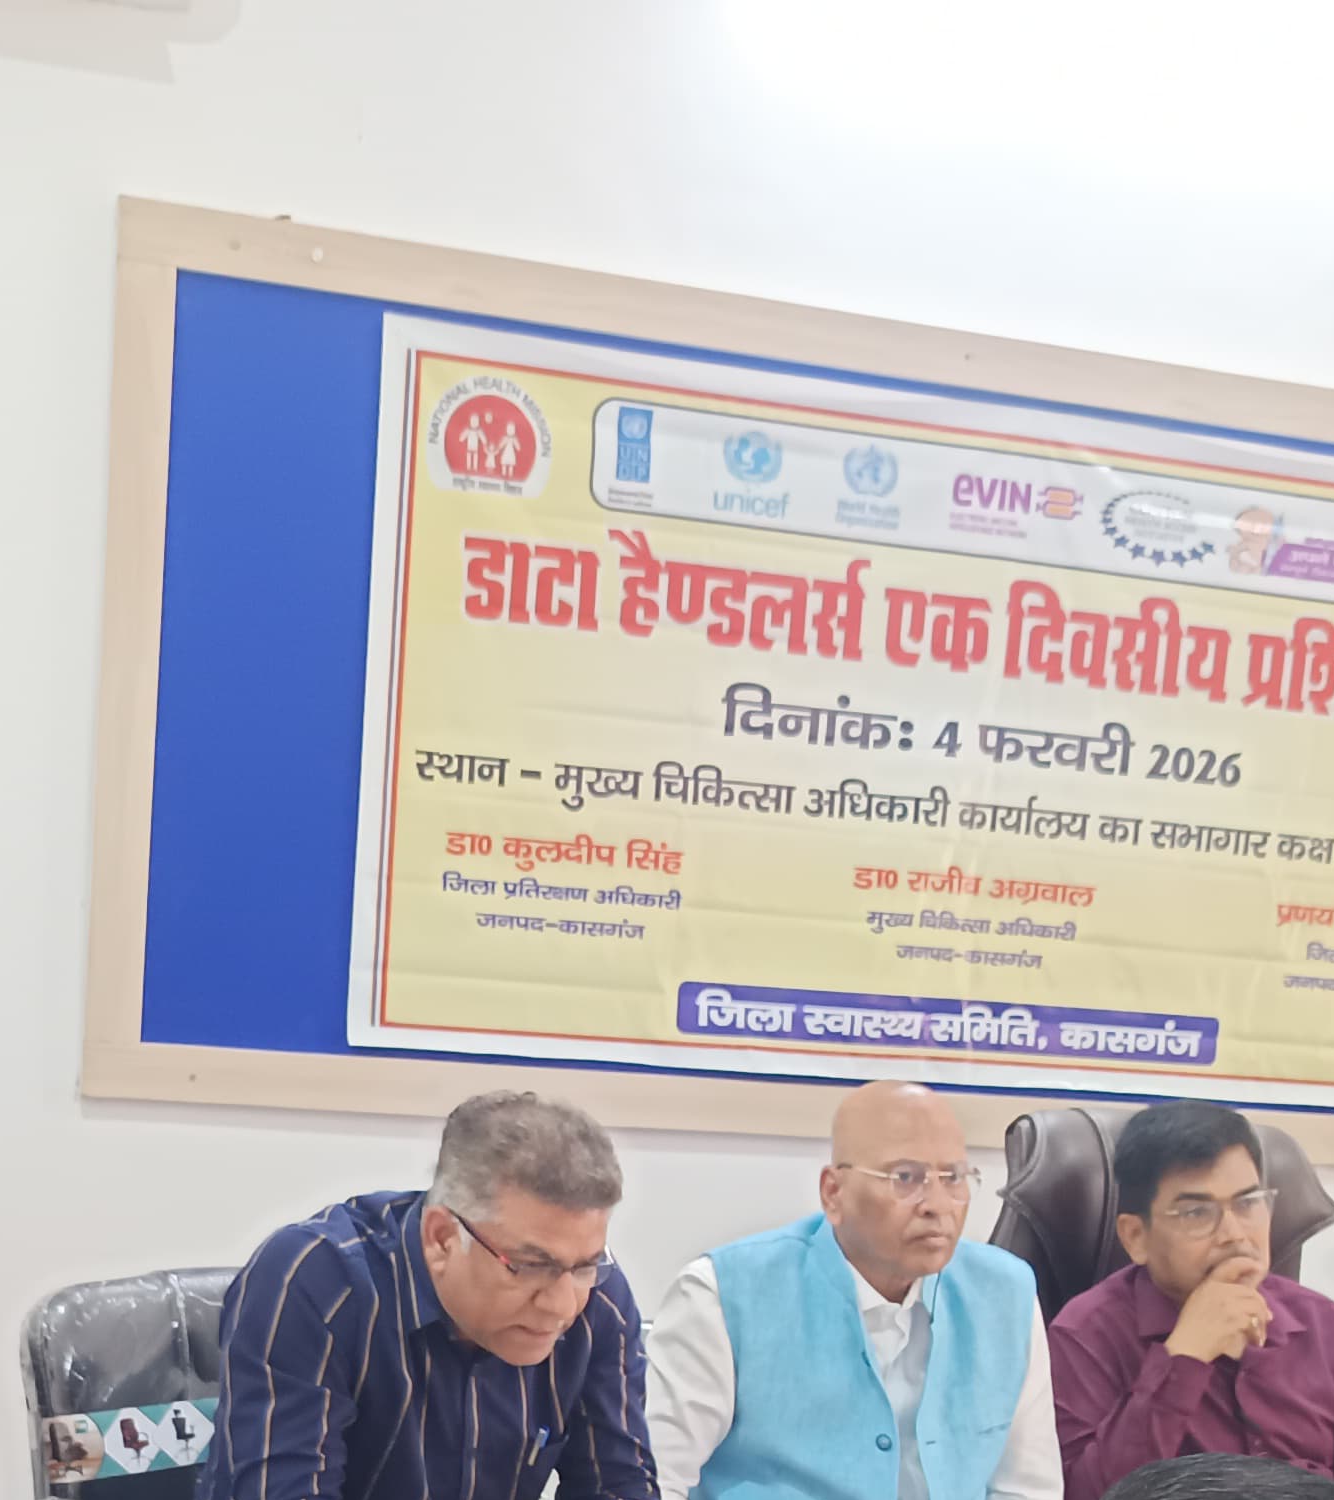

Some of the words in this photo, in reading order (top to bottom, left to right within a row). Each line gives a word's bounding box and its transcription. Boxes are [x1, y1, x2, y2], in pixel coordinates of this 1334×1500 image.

[713, 490, 790, 518] unicef
[952, 473, 1032, 514] eVIN
[464, 537, 599, 632] डाटा
[608, 529, 871, 661] हैण्डलर्स
[884, 588, 993, 673] एक
[1003, 580, 1232, 702] दिवसीय
[931, 721, 963, 759] 4
[979, 722, 1135, 776] फरवरी
[1146, 744, 1243, 788] 2026
[415, 749, 508, 787] स्थान
[554, 762, 643, 812] मुख्य
[653, 761, 795, 815] चिकित्सा
[803, 779, 950, 827] अधिकारी
[958, 796, 1089, 841] कार्यालय
[1098, 815, 1141, 846] का
[1150, 819, 1270, 858] सभागार
[503, 835, 616, 871] कुलदीप
[626, 836, 684, 875] सिंह
[441, 870, 496, 896] जिला
[503, 877, 589, 903] प्रतिरक्षण
[594, 885, 681, 910] अधिकारी
[907, 867, 980, 897] राजीव
[989, 879, 1096, 908] अग्रवाल
[867, 911, 914, 933] मुख्य
[996, 919, 1076, 941] अधिकारी
[1277, 902, 1333, 927] प्रणय
[695, 989, 795, 1034] जिला
[803, 1005, 924, 1041] स्वास्थ्य
[930, 1007, 1048, 1051] समिति,
[1060, 1021, 1201, 1058] कासगंज
